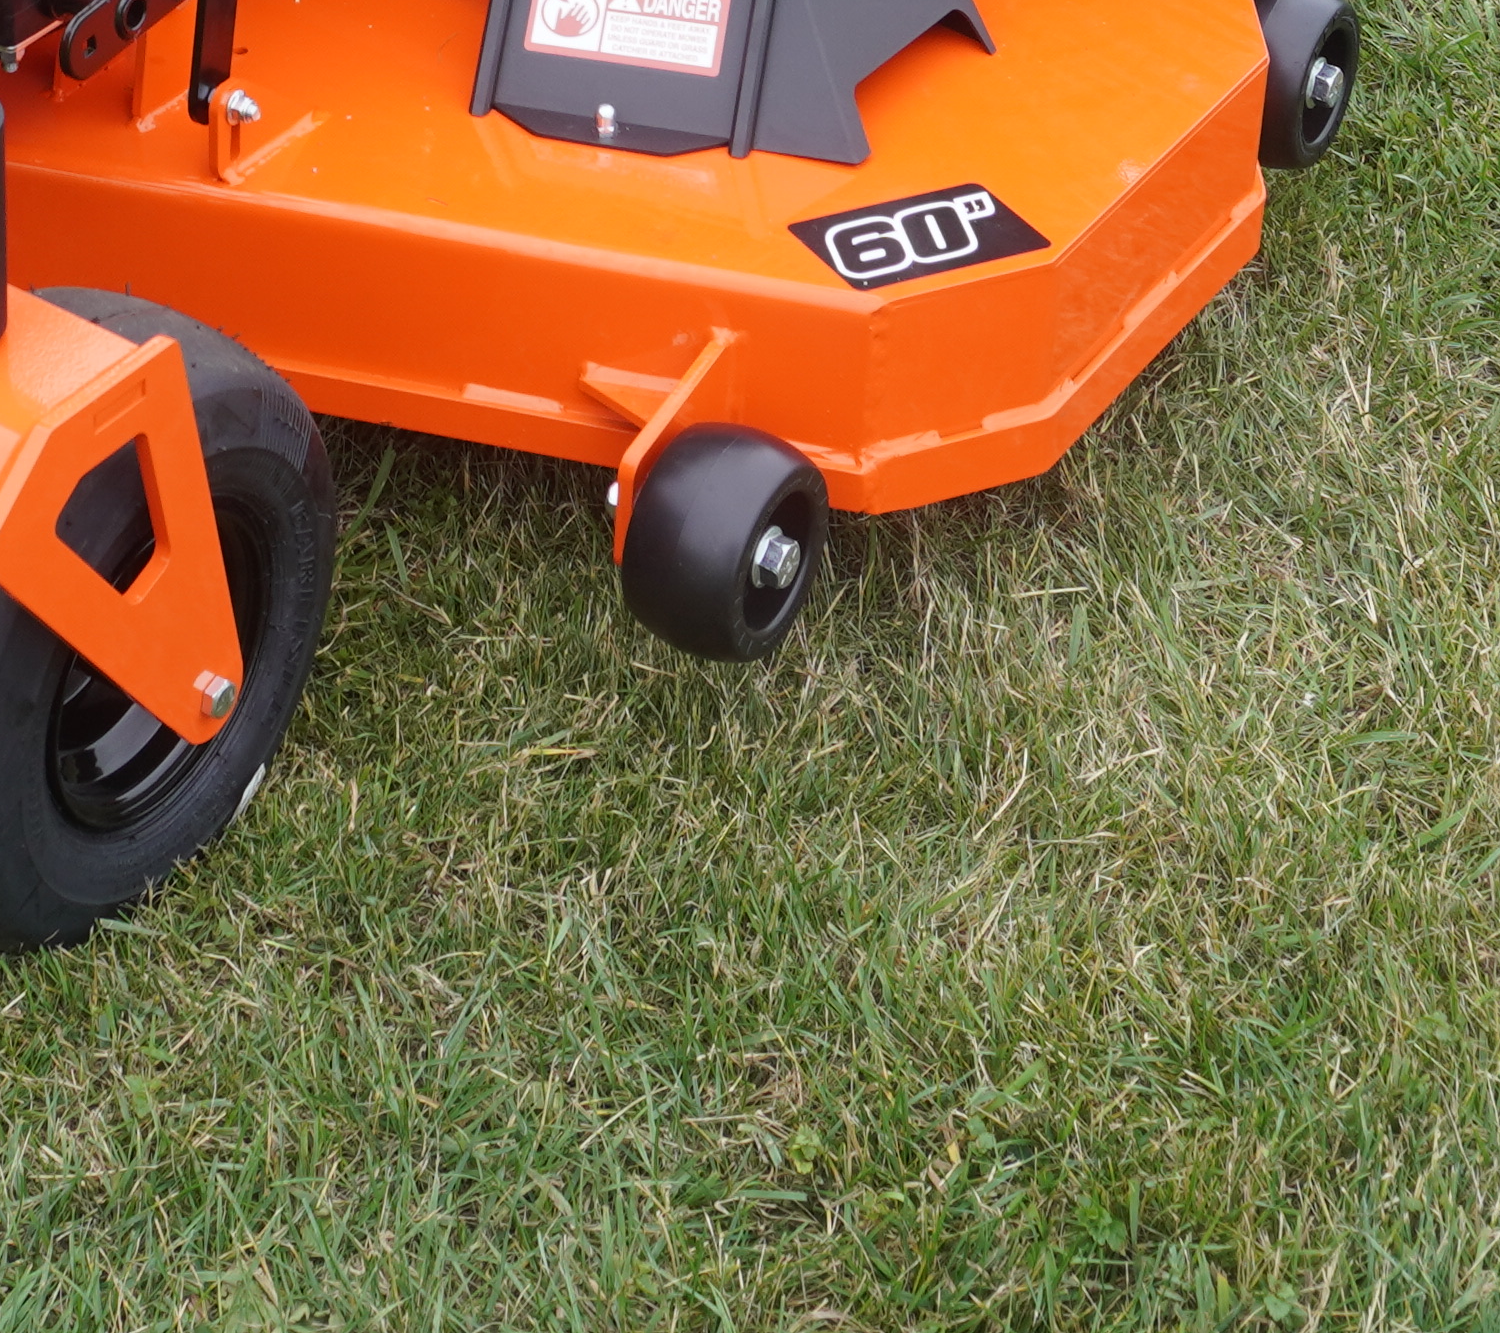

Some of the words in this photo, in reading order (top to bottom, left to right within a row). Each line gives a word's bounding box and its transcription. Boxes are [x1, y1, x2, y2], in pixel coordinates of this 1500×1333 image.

[610, 14, 630, 23] KEEP
[631, 17, 657, 27] HANDS
[667, 22, 686, 31] FEET
[610, 24, 622, 32] DO
[623, 25, 639, 34] NOT
[640, 28, 676, 39] OPERATE
[607, 33, 637, 43] UNLESS
[638, 37, 666, 47] GUARD
[667, 41, 679, 49] OR
[680, 43, 708, 53] GRASS
[611, 43, 648, 54] CATCHER
